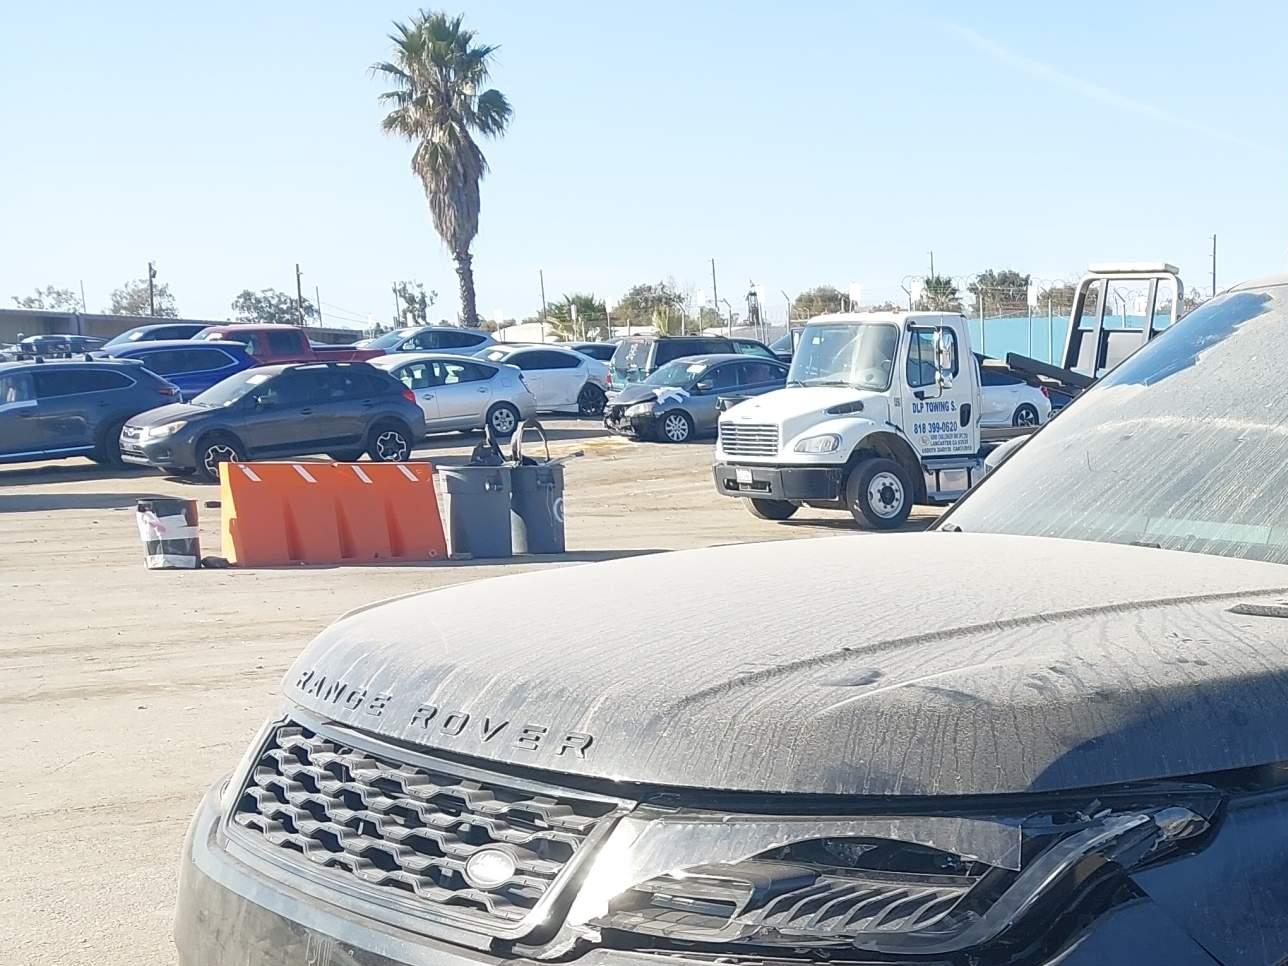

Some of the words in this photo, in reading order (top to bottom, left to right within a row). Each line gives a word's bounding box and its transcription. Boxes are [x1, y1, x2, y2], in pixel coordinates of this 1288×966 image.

[912, 402, 924, 413] DLP
[925, 401, 950, 413] TOWING
[913, 423, 926, 434] 818
[928, 421, 957, 433] 399-0620
[295, 671, 392, 717] RANGE
[409, 703, 594, 759] ROVER
